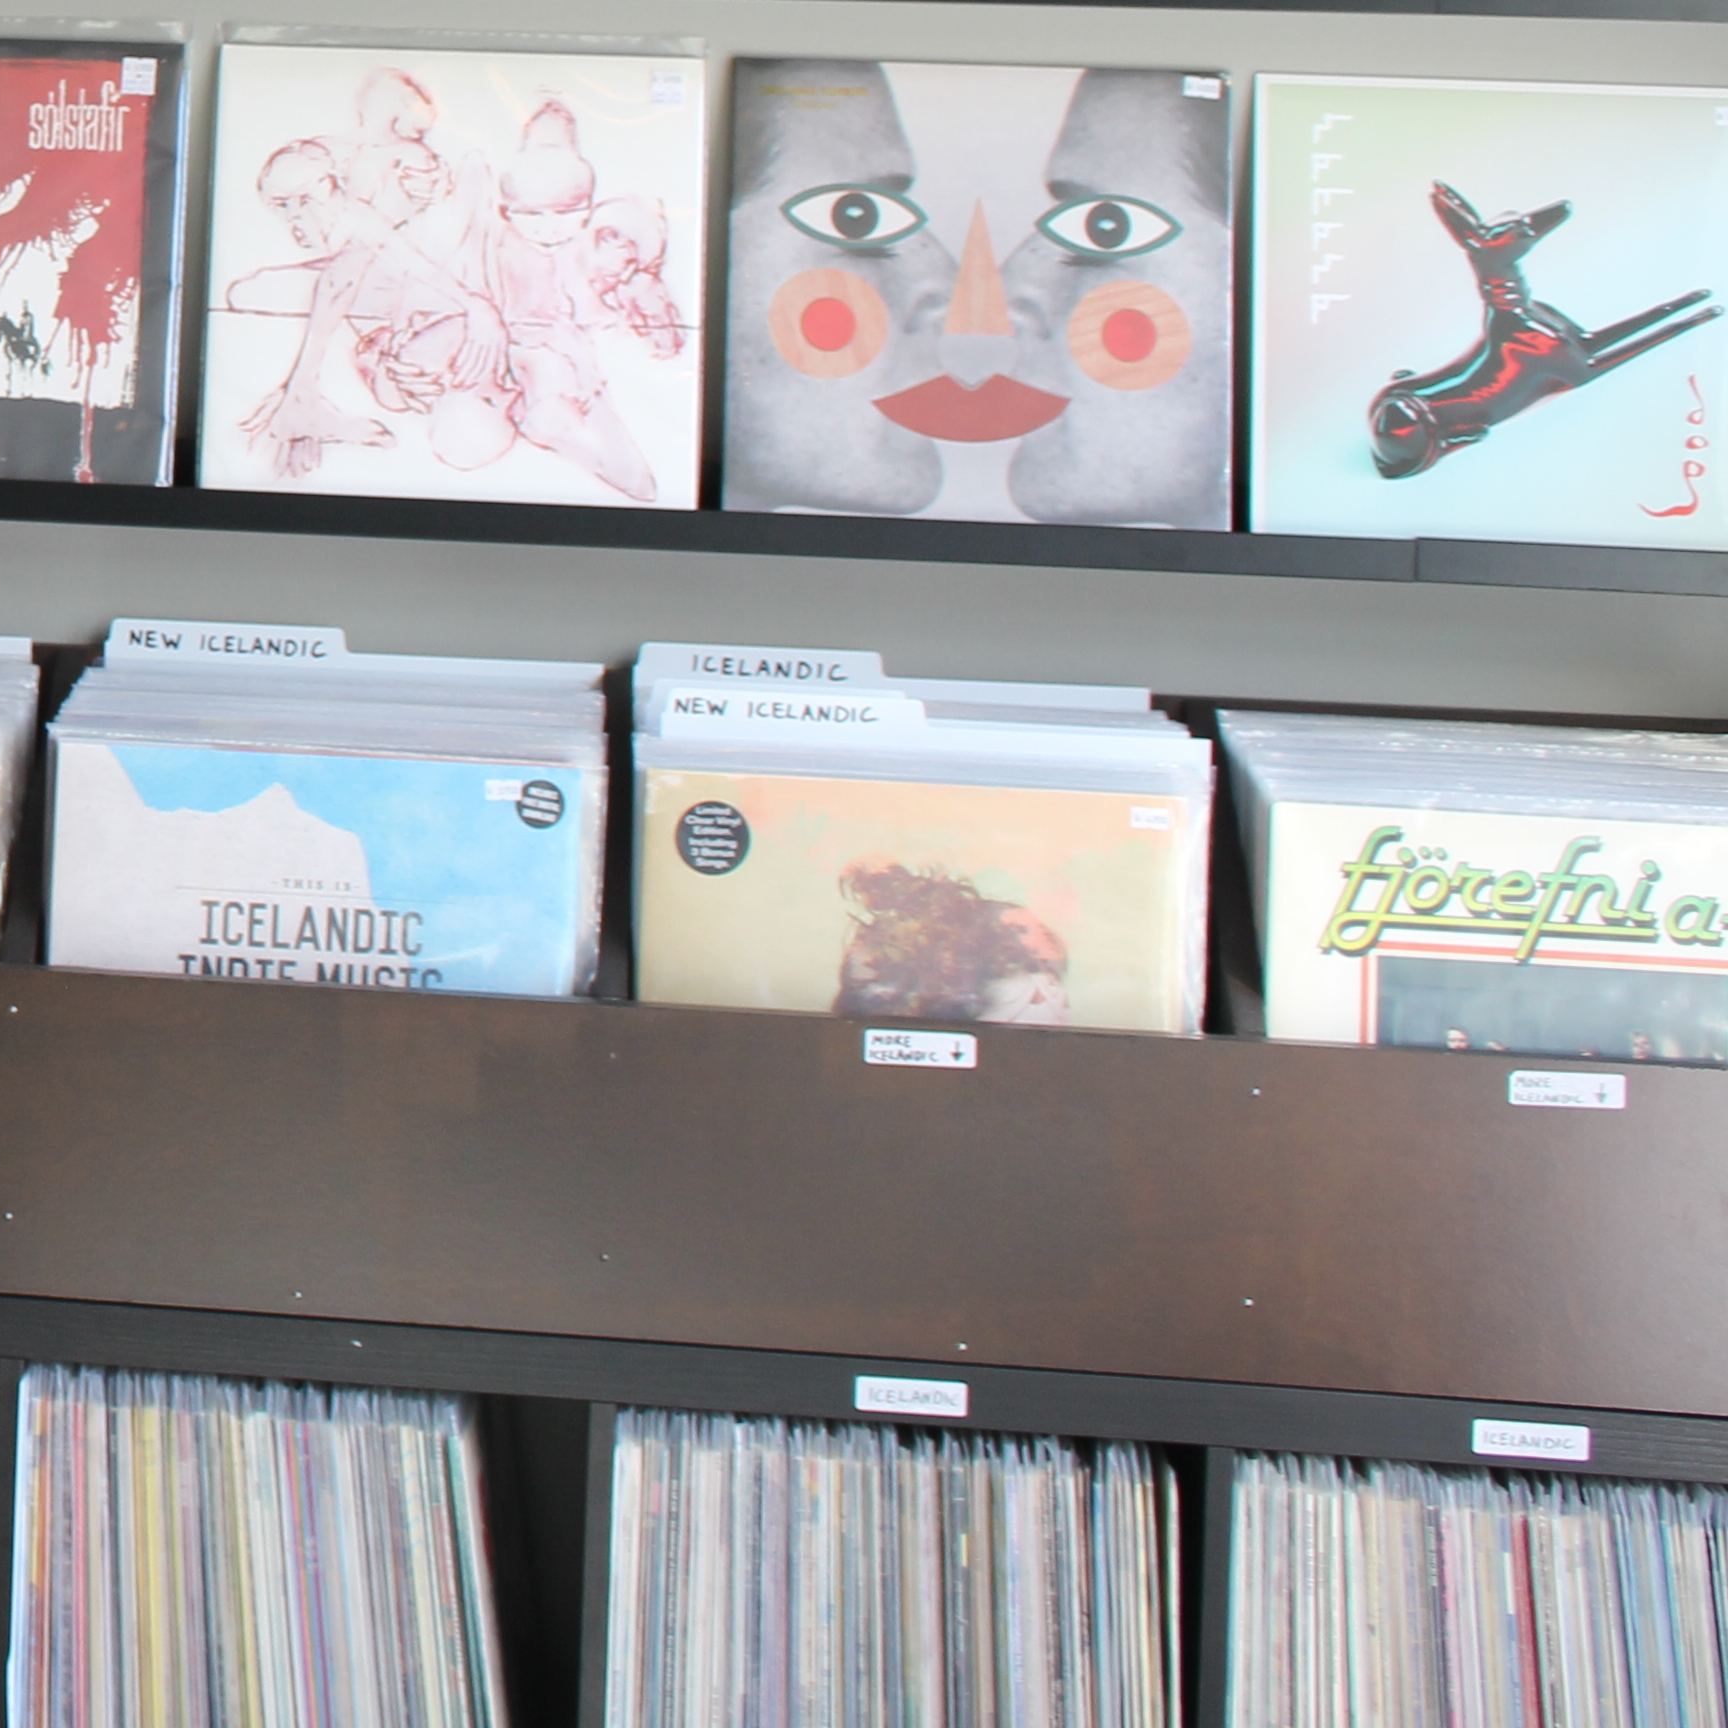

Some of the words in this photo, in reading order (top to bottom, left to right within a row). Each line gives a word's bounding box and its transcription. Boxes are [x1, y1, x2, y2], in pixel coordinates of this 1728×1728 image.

[28, 79, 131, 152] sólstafir
[128, 629, 182, 650] NEW
[198, 633, 327, 659] ICELANDIC
[691, 653, 849, 682] ICELANDIC
[673, 696, 728, 718] NEW
[747, 700, 878, 724] ICELANDIC
[695, 806, 732, 817] Limited
[684, 817, 715, 827] Clear
[716, 817, 742, 827] Vinyl
[687, 837, 739, 849] Including
[282, 878, 326, 890] THIS
[334, 880, 352, 891] IS
[1319, 826, 1661, 965] fjörefni
[1665, 895, 1728, 949] a
[199, 899, 424, 957] ICELANDIC
[870, 1035, 912, 1048] MORE
[869, 1049, 940, 1063] ICELANDIC
[1514, 1076, 1552, 1088] MORE
[1513, 1092, 1583, 1105] ICELANDIC
[869, 1386, 958, 1407] ICELANDIC
[1483, 1431, 1577, 1451] ICELANDIC
